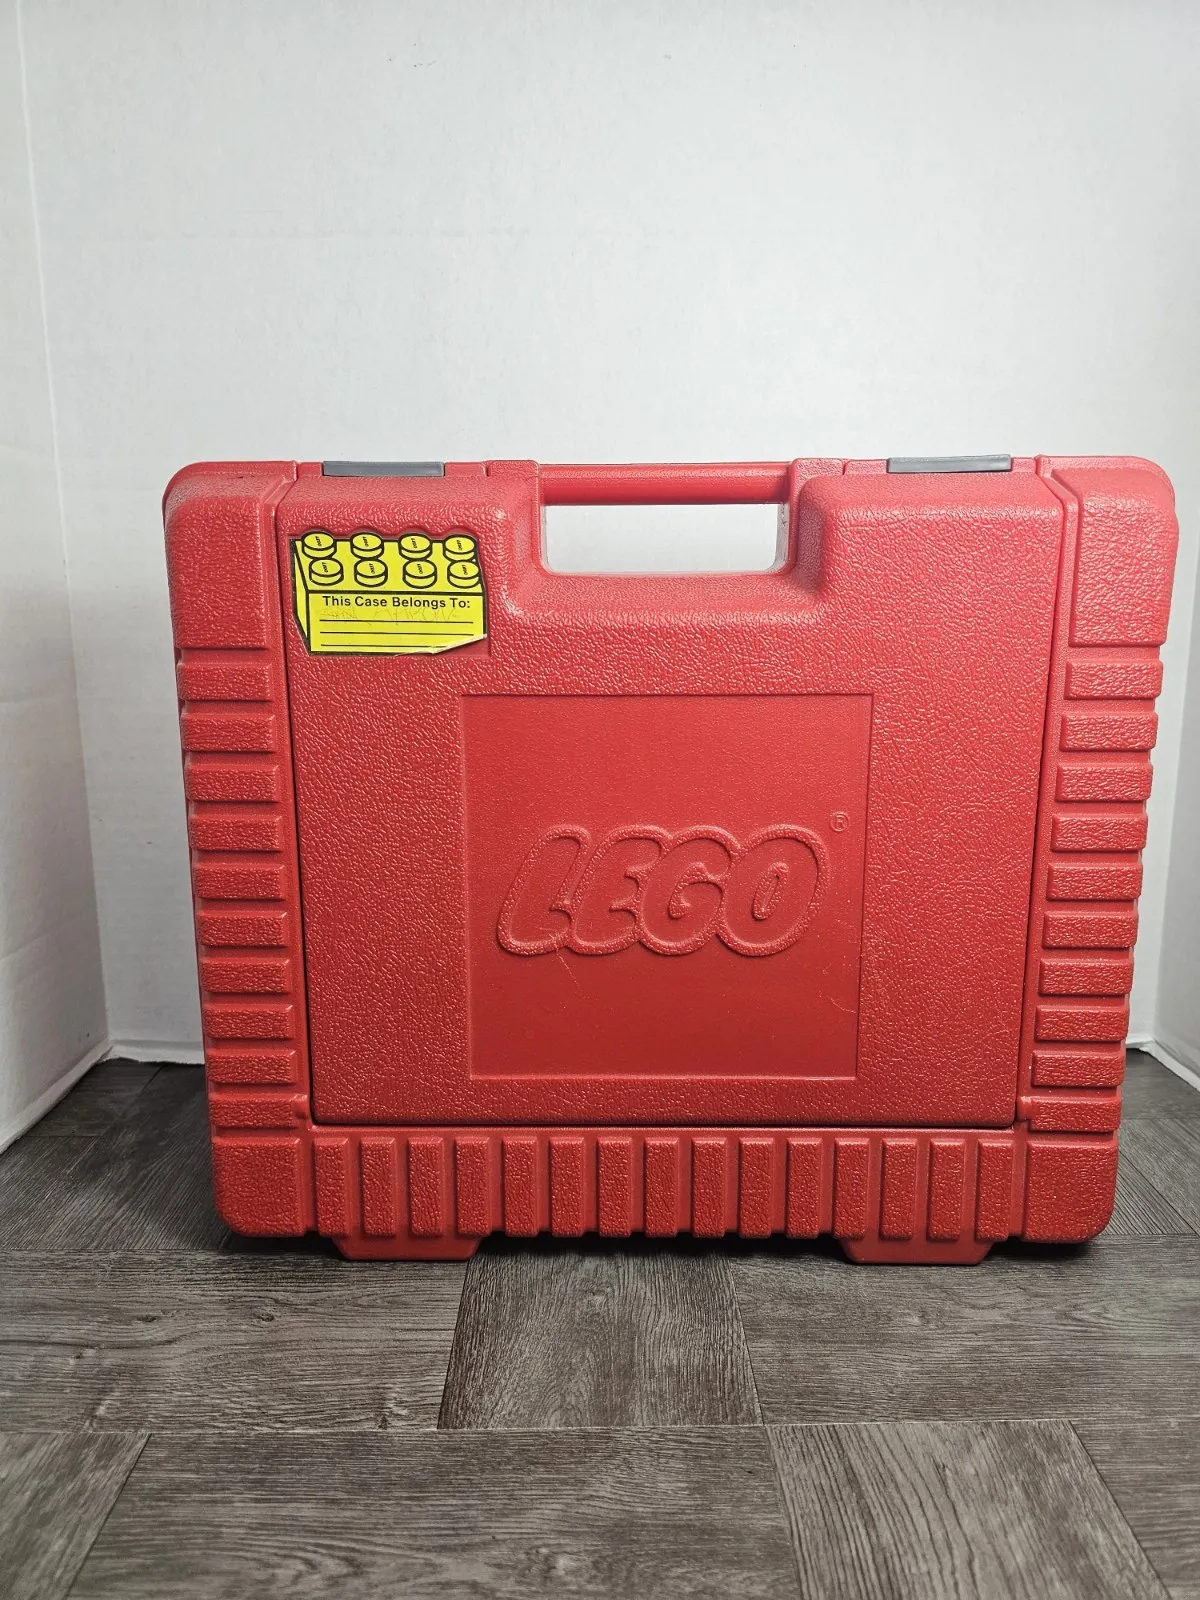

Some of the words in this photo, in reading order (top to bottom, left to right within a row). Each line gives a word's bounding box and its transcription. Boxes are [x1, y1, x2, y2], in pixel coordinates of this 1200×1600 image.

[323, 596, 351, 607] This
[355, 596, 387, 608] Case
[392, 597, 446, 610] Belongs
[450, 597, 471, 608] To:
[497, 824, 830, 957] LEGO
